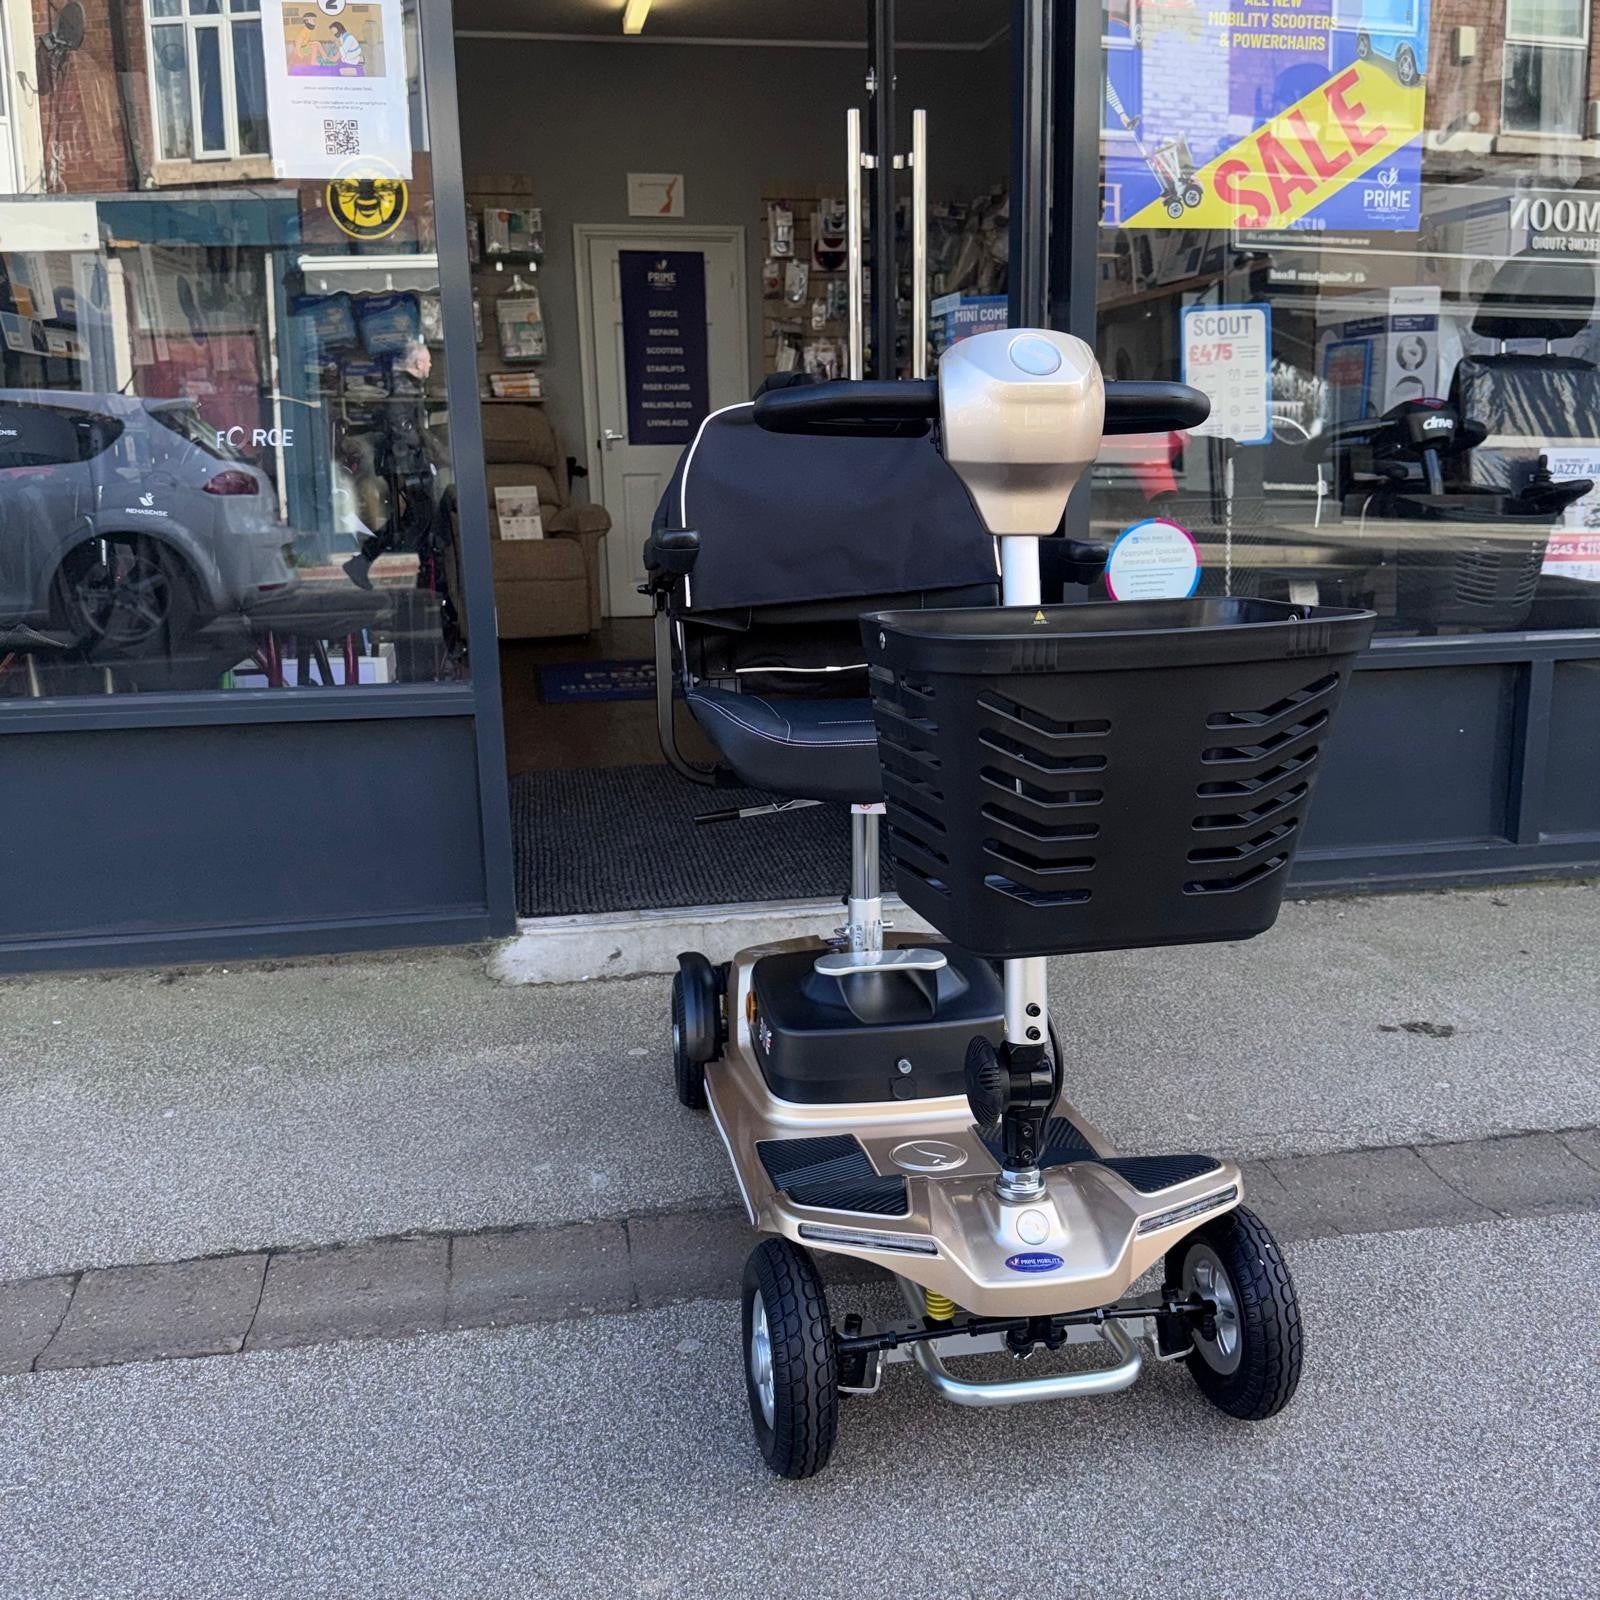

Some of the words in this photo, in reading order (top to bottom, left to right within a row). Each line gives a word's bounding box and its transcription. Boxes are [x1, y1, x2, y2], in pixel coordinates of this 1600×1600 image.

[1208, 11, 1269, 27] MOBILITY
[1272, 13, 1338, 30] SCOOTERS
[1219, 32, 1229, 47] &
[1233, 33, 1326, 50] POWERCHAIRS
[1213, 68, 1388, 228] SALE
[1363, 190, 1411, 207] PRIME
[648, 272, 677, 283] PRIME
[648, 310, 679, 318] SERVICE
[954, 310, 978, 323] MINI
[649, 328, 680, 336] REPAIRS
[1193, 316, 1252, 336] SCOUT
[646, 347, 684, 355] SCOOTERS
[1189, 343, 1232, 362] £475
[1423, 416, 1453, 430] drive
[1553, 463, 1584, 475] JAZZY
